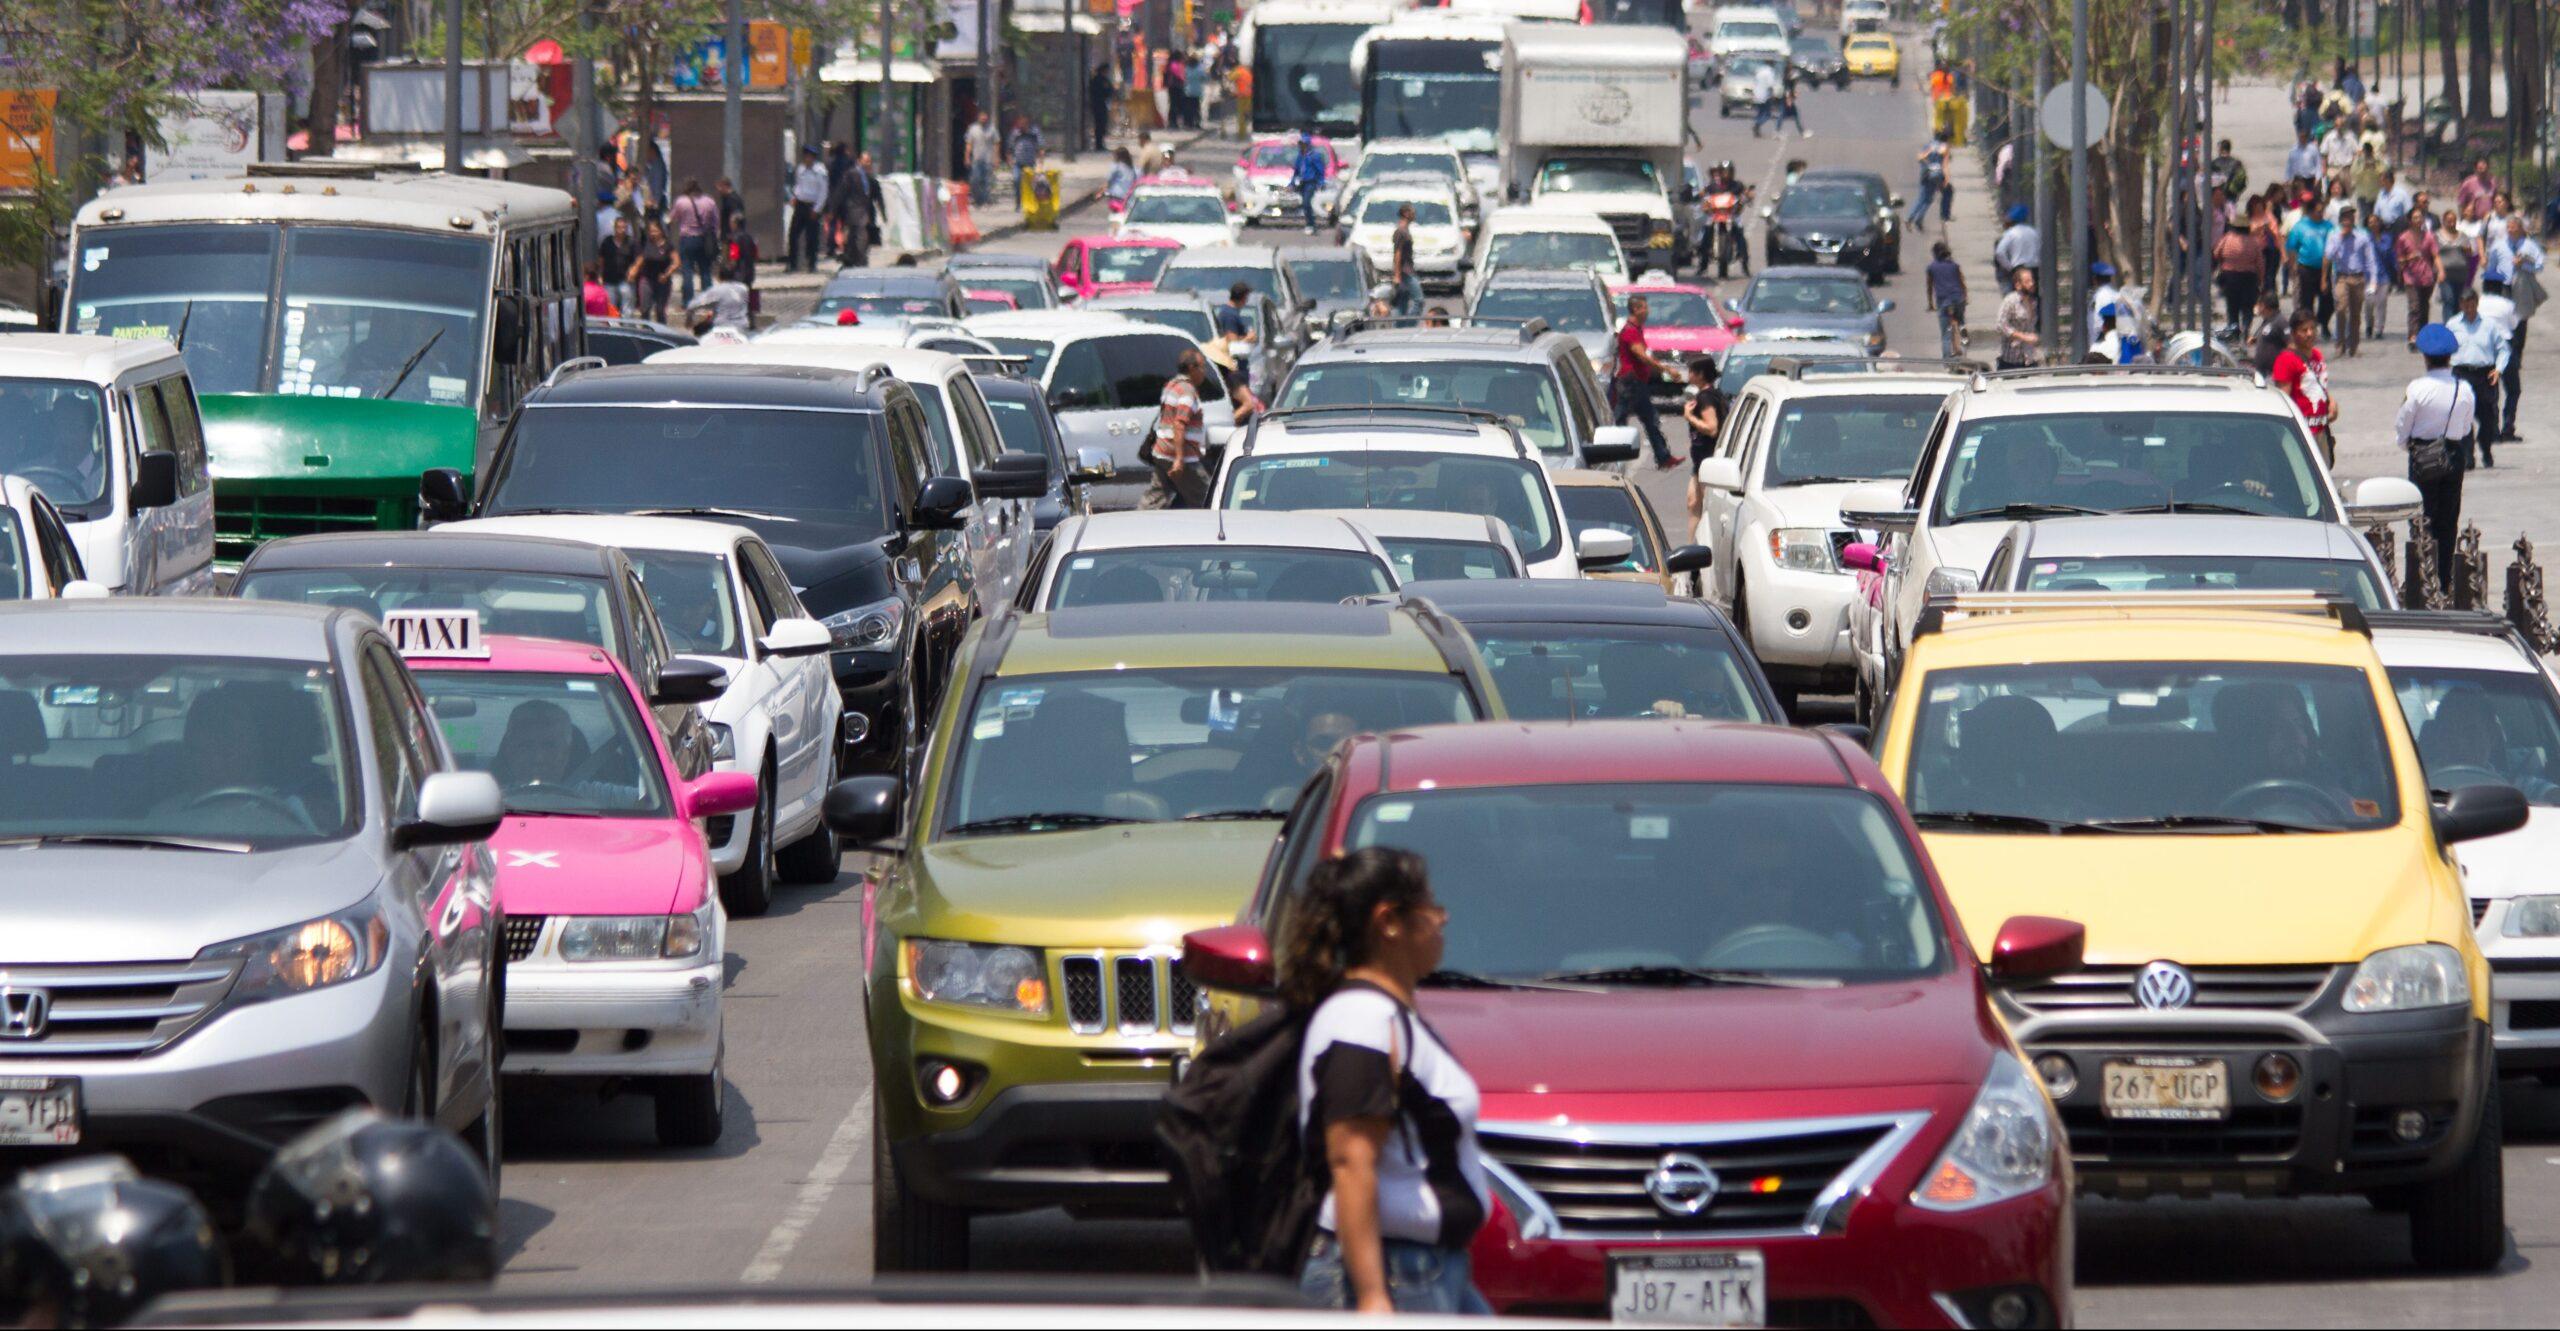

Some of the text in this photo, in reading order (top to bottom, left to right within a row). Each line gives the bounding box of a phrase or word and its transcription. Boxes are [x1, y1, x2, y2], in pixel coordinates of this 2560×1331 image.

[113, 326, 169, 339] PANTEONES
[389, 617, 470, 650] TAXI
[2111, 1074, 2218, 1100] 267-UGP
[1625, 1280, 1753, 1313] J87-AFK
